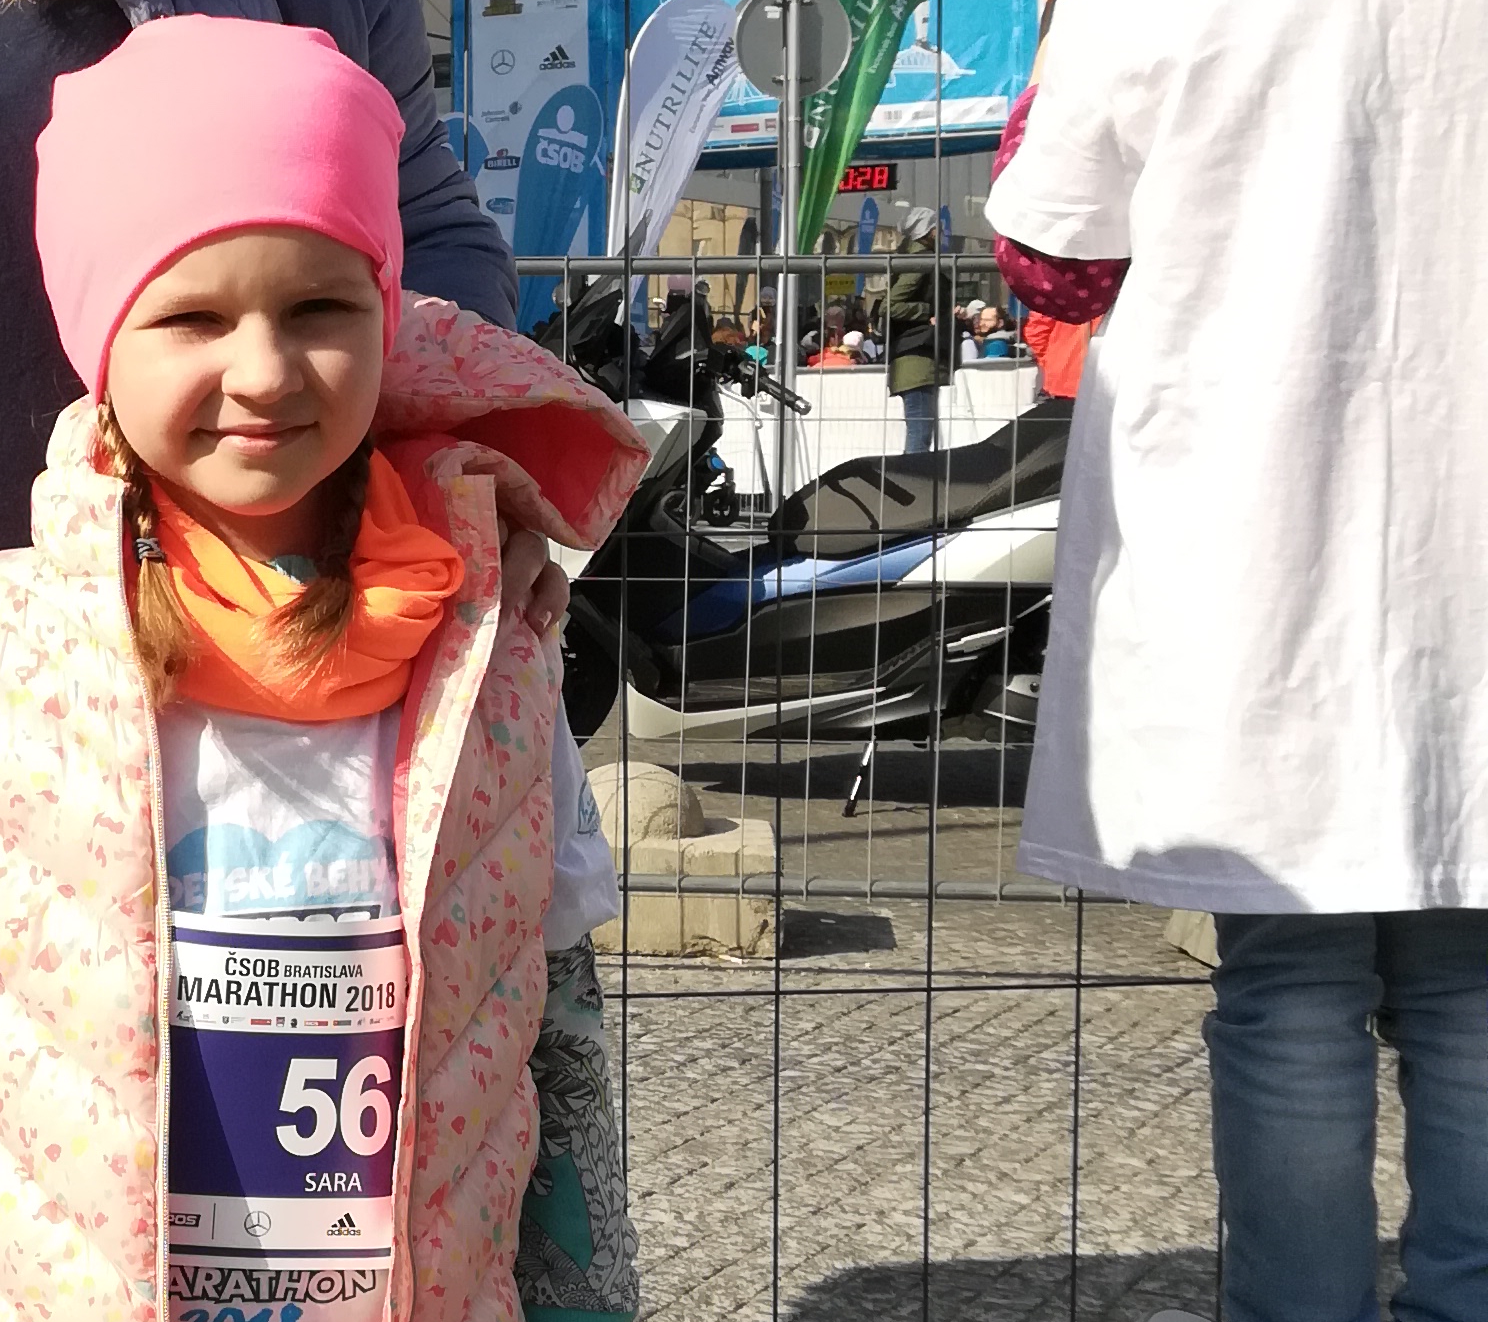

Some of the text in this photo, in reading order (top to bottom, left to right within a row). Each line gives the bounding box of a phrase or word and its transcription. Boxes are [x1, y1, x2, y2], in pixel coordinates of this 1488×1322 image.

[539, 60, 576, 71] adidas
[634, 16, 717, 175] NUTRILITE
[535, 138, 586, 175] ČSOB
[169, 852, 388, 908] DESKÉ BEHY
[224, 950, 363, 979] ČSOB BRATISLAVA
[176, 974, 396, 1013] MARATHON 2018
[275, 1054, 392, 1157] 56
[304, 1172, 363, 1193] SARA
[169, 1214, 198, 1226] POS
[326, 1227, 362, 1237] adidas
[168, 1265, 378, 1304] ARATHON
